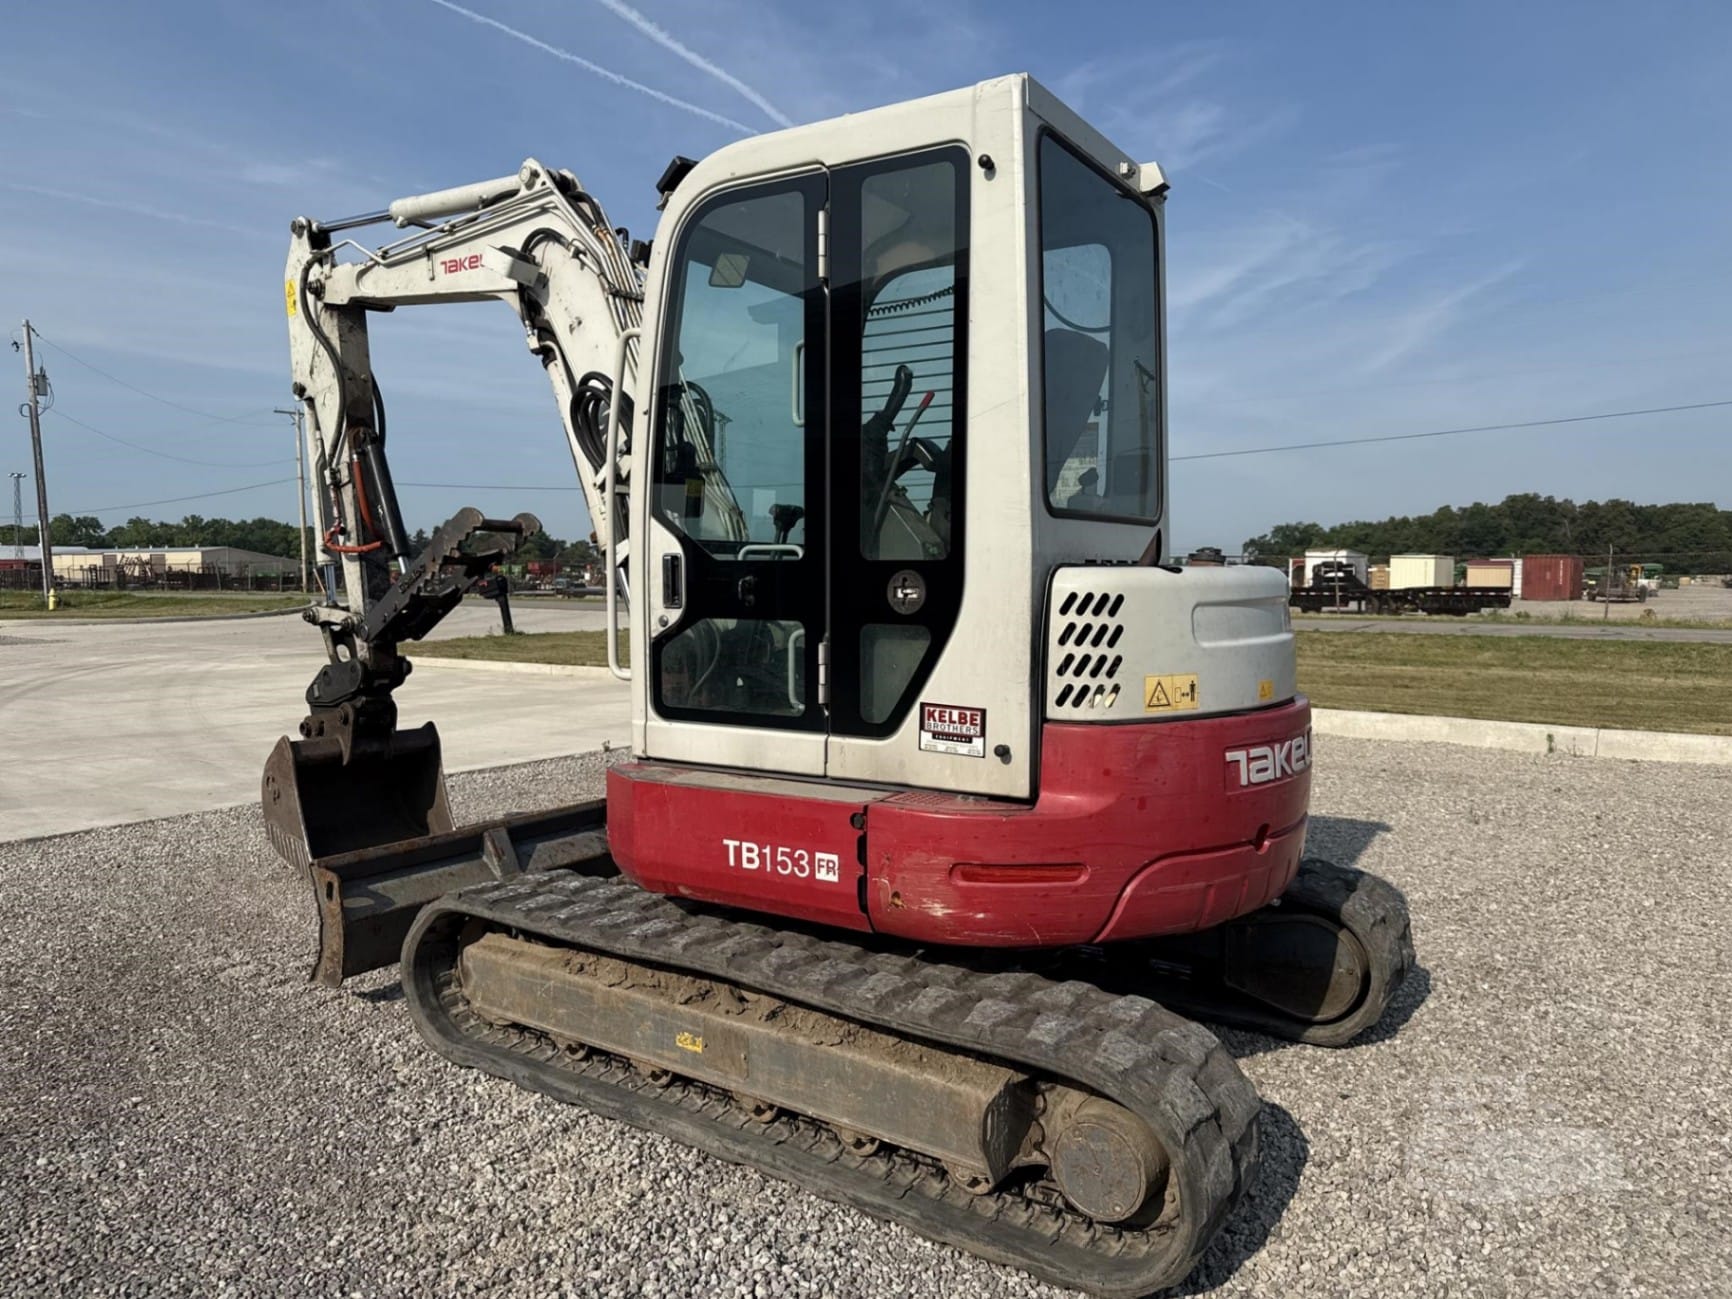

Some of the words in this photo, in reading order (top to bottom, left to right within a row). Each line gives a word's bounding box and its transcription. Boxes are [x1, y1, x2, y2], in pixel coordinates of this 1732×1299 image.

[926, 708, 979, 727] KELBE
[926, 722, 978, 735] BROTHERS
[723, 839, 810, 878] TB153
